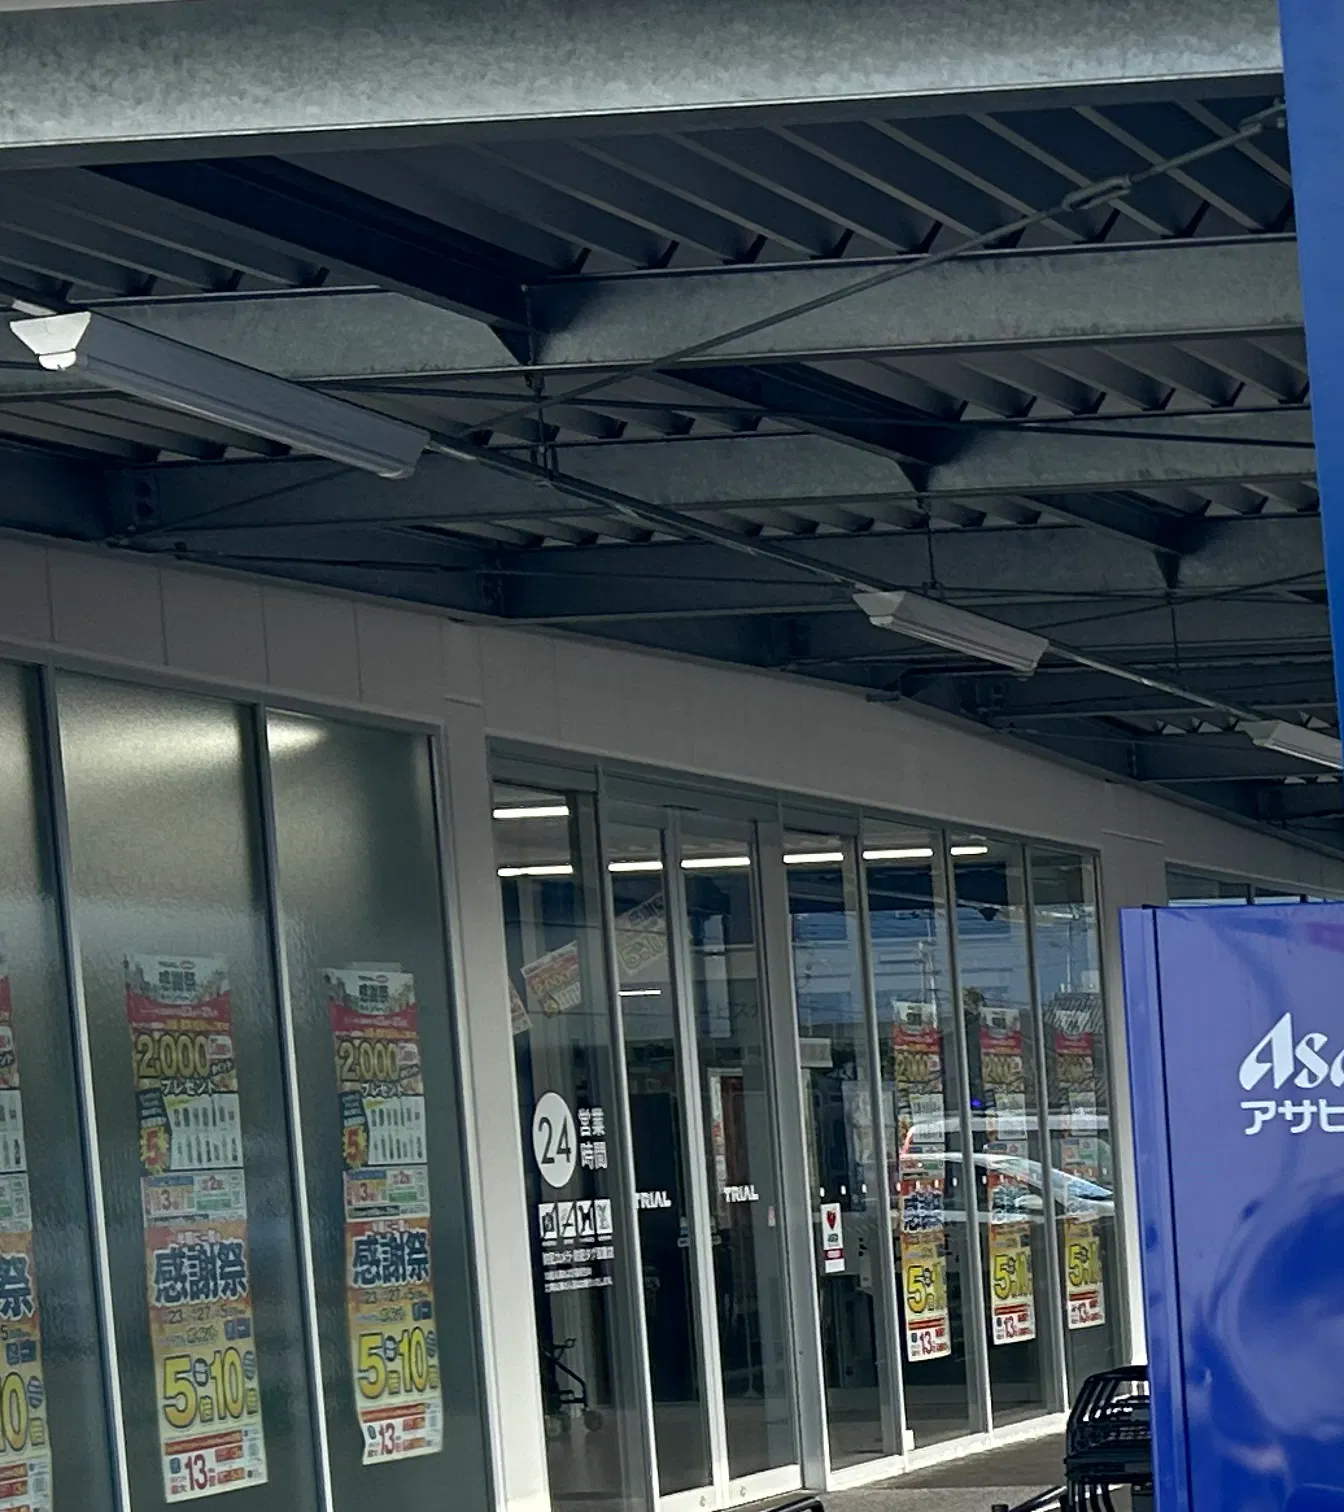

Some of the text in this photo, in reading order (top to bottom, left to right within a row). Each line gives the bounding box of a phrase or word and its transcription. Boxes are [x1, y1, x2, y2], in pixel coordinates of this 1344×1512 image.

[136, 1033, 209, 1077] 2,000
[161, 1078, 216, 1095] プレゼント
[538, 1115, 572, 1165] 24
[724, 1185, 760, 1203] TRIAL
[154, 1239, 248, 1306] 感謝祭
[352, 1228, 431, 1288] 感謝祭
[907, 1264, 927, 1314] 5
[163, 1346, 246, 1429] 5 10
[358, 1326, 428, 1399] 5 10
[185, 1454, 208, 1491] 13
